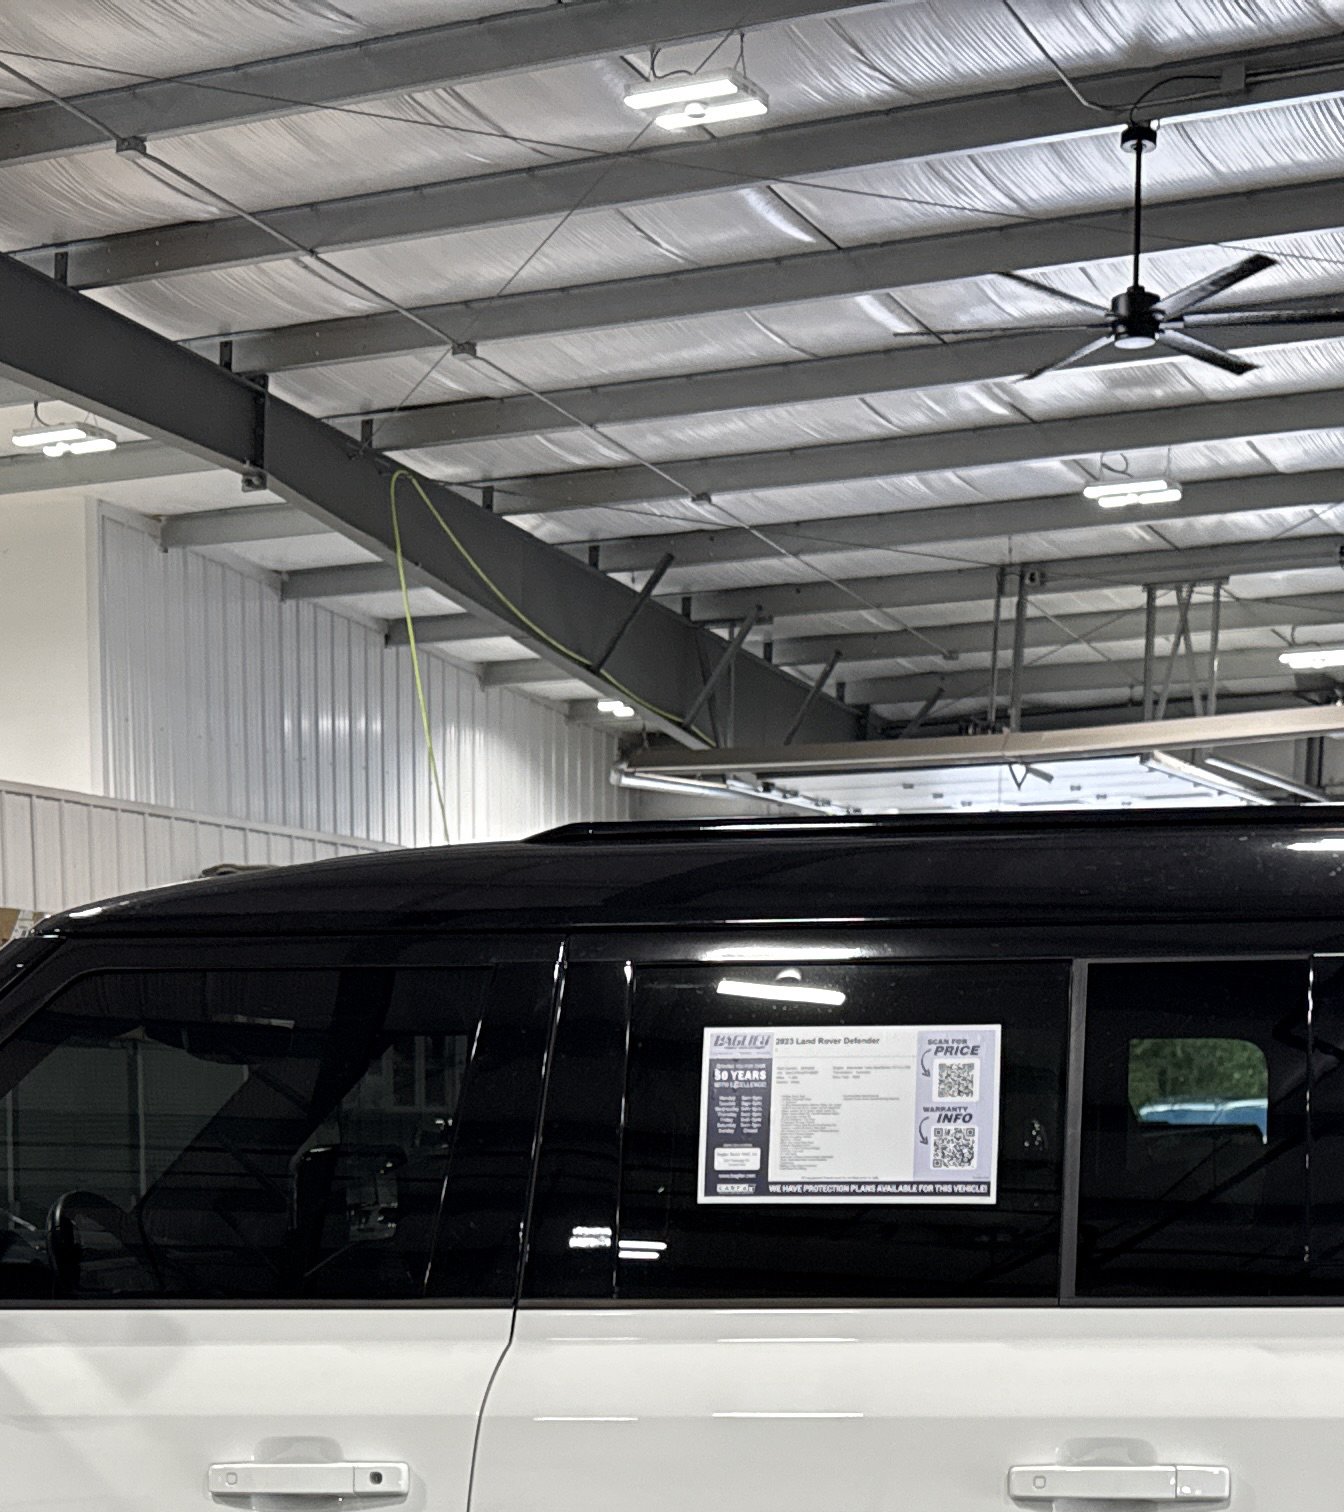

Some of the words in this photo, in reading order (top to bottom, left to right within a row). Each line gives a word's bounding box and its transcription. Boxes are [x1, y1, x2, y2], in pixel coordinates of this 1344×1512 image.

[796, 1037, 816, 1045] Land
[818, 1037, 841, 1045] Rover
[844, 1036, 880, 1045] Defender
[934, 1045, 981, 1056] PRICE
[730, 1069, 767, 1081] YEARS
[936, 1113, 973, 1124] INFO
[769, 1184, 781, 1193] WE
[782, 1184, 802, 1193] HAVE
[803, 1184, 850, 1193] PROTECTION
[850, 1184, 876, 1193] PLANS
[877, 1184, 918, 1193] AVAILABLE
[918, 1184, 934, 1193] FOR
[936, 1184, 953, 1193] THIS
[953, 1184, 988, 1193] VEHICLE!
